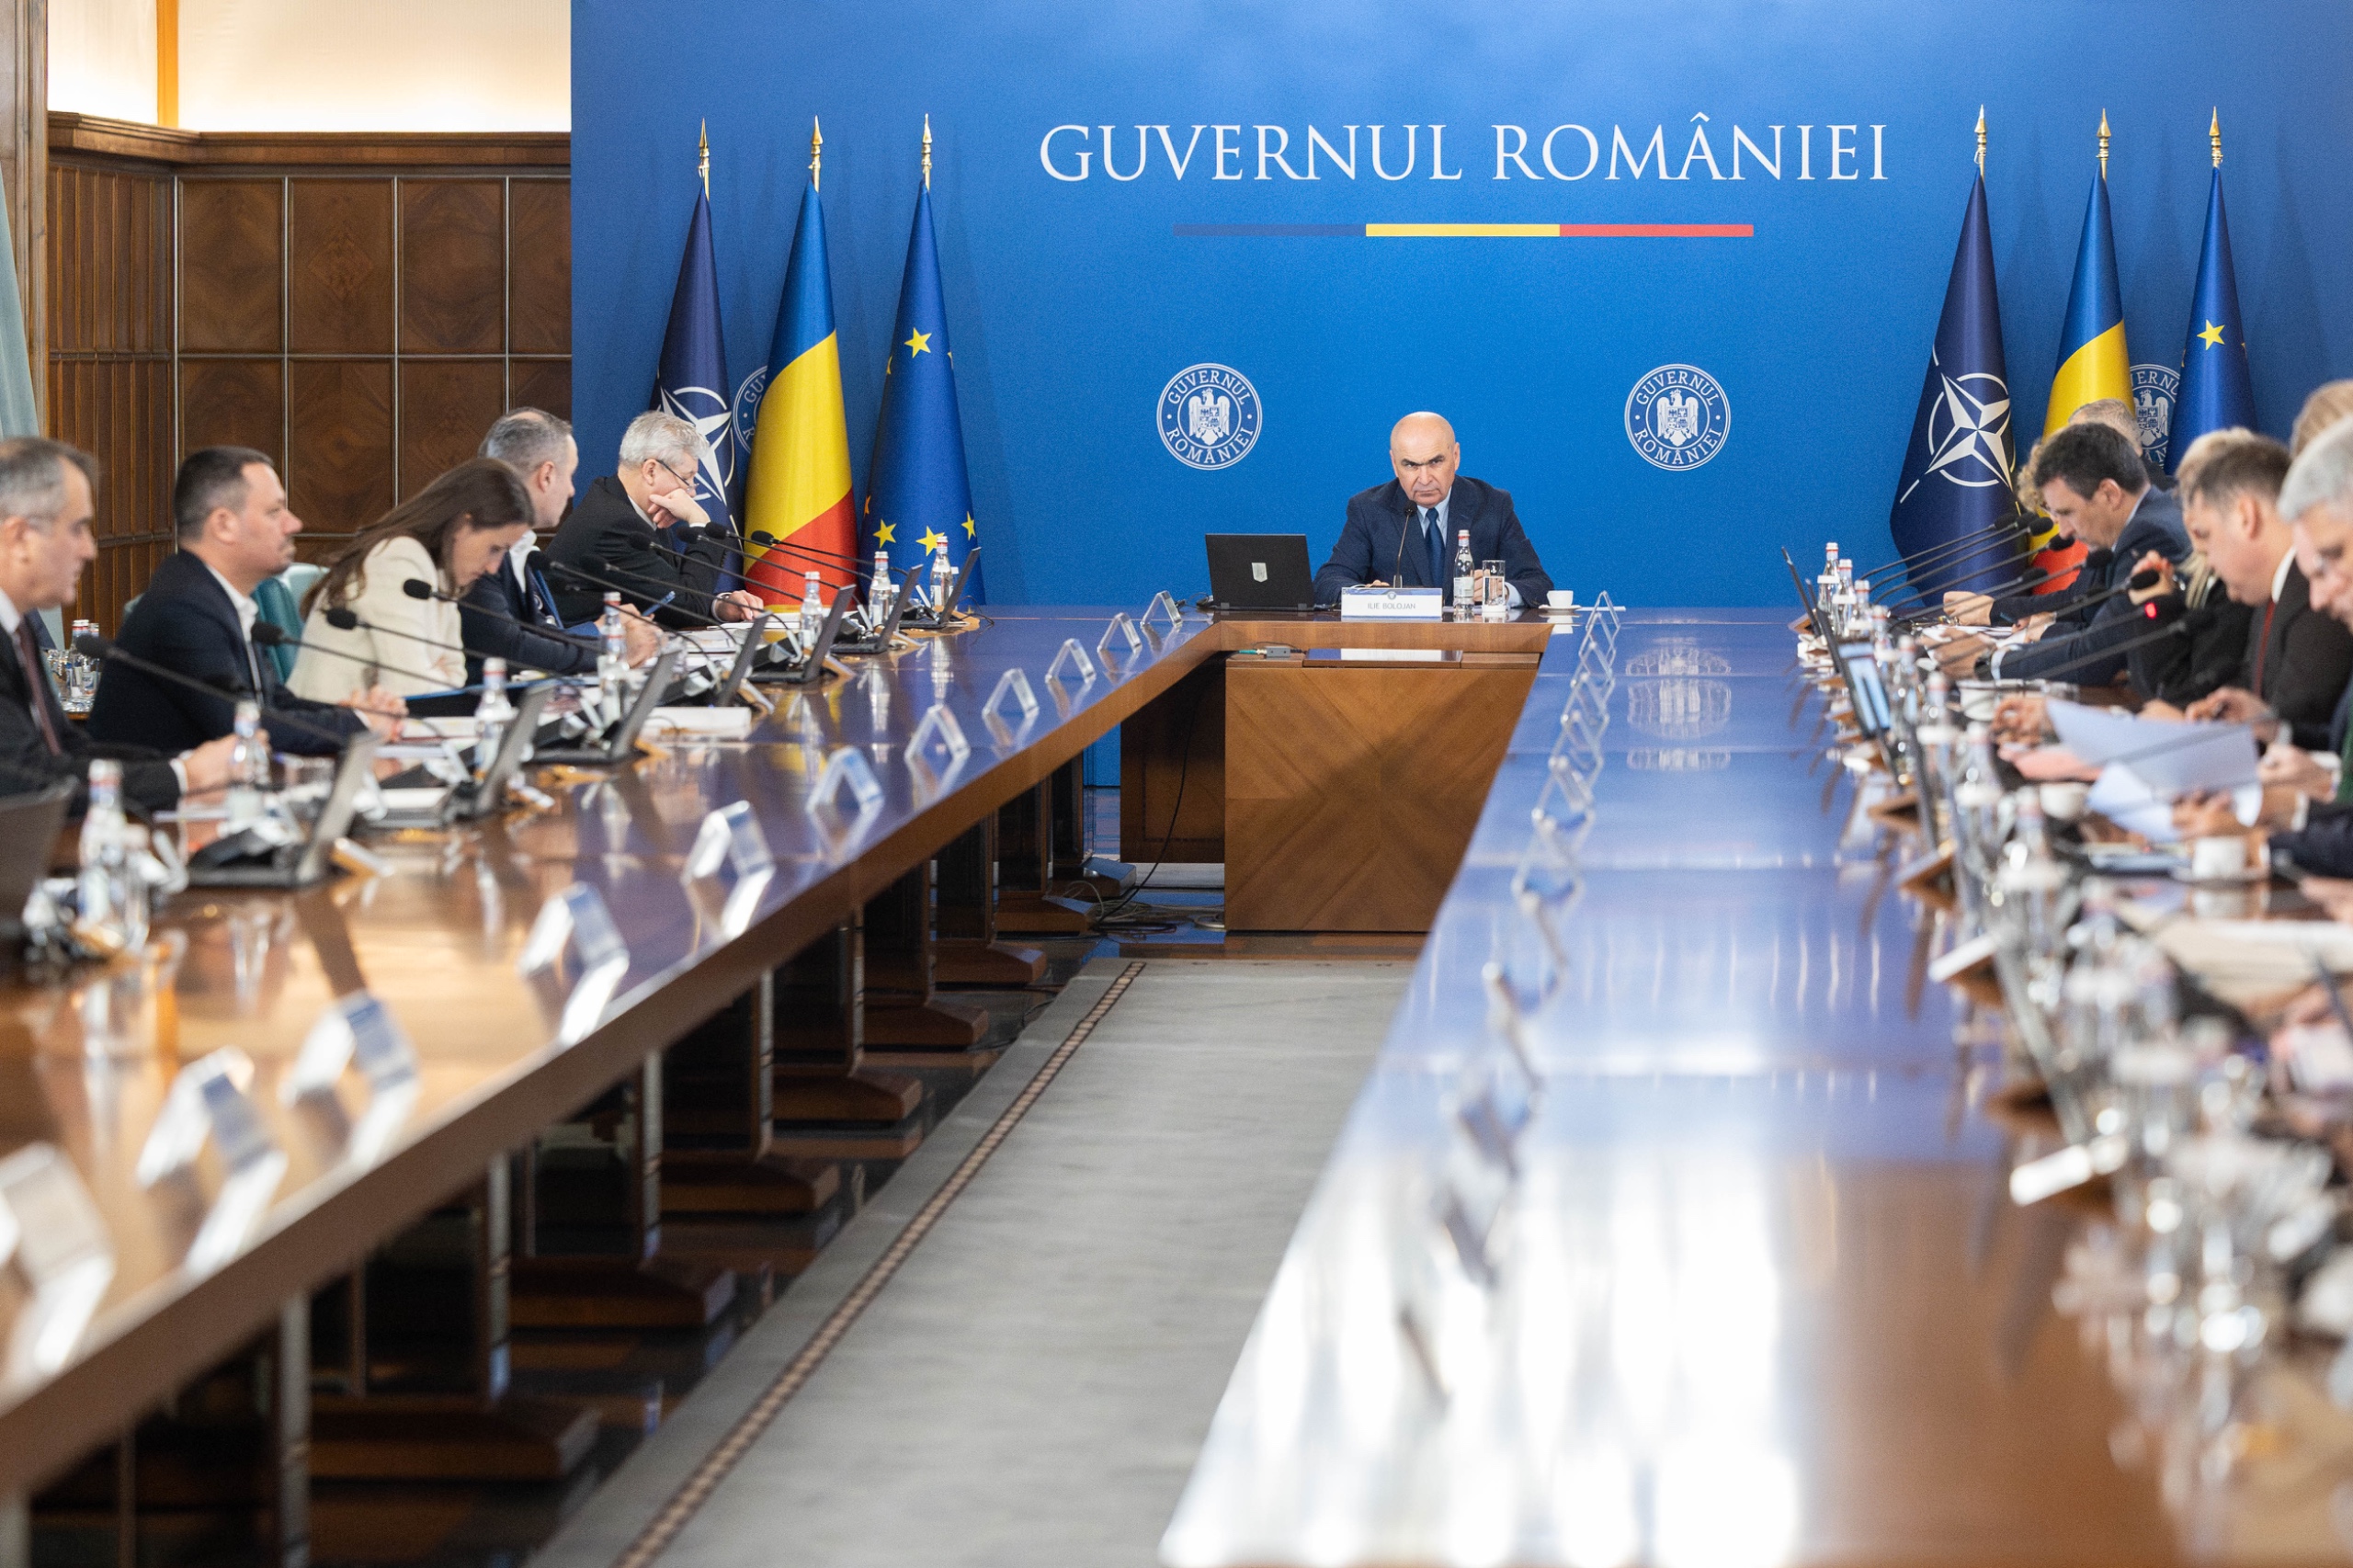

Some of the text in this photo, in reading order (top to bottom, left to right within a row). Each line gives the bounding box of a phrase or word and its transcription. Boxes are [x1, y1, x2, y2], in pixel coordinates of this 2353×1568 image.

[1040, 111, 1888, 182] GUVERNUL ROMÂNIEI
[1167, 369, 1251, 405] GUVERNUL
[1636, 370, 1719, 406] GUVERNUL
[1166, 426, 1254, 464] ROMÂNIEI
[1634, 427, 1722, 465] ROMÂNIEI
[1367, 602, 1416, 610] ILIE BOLOJAN
